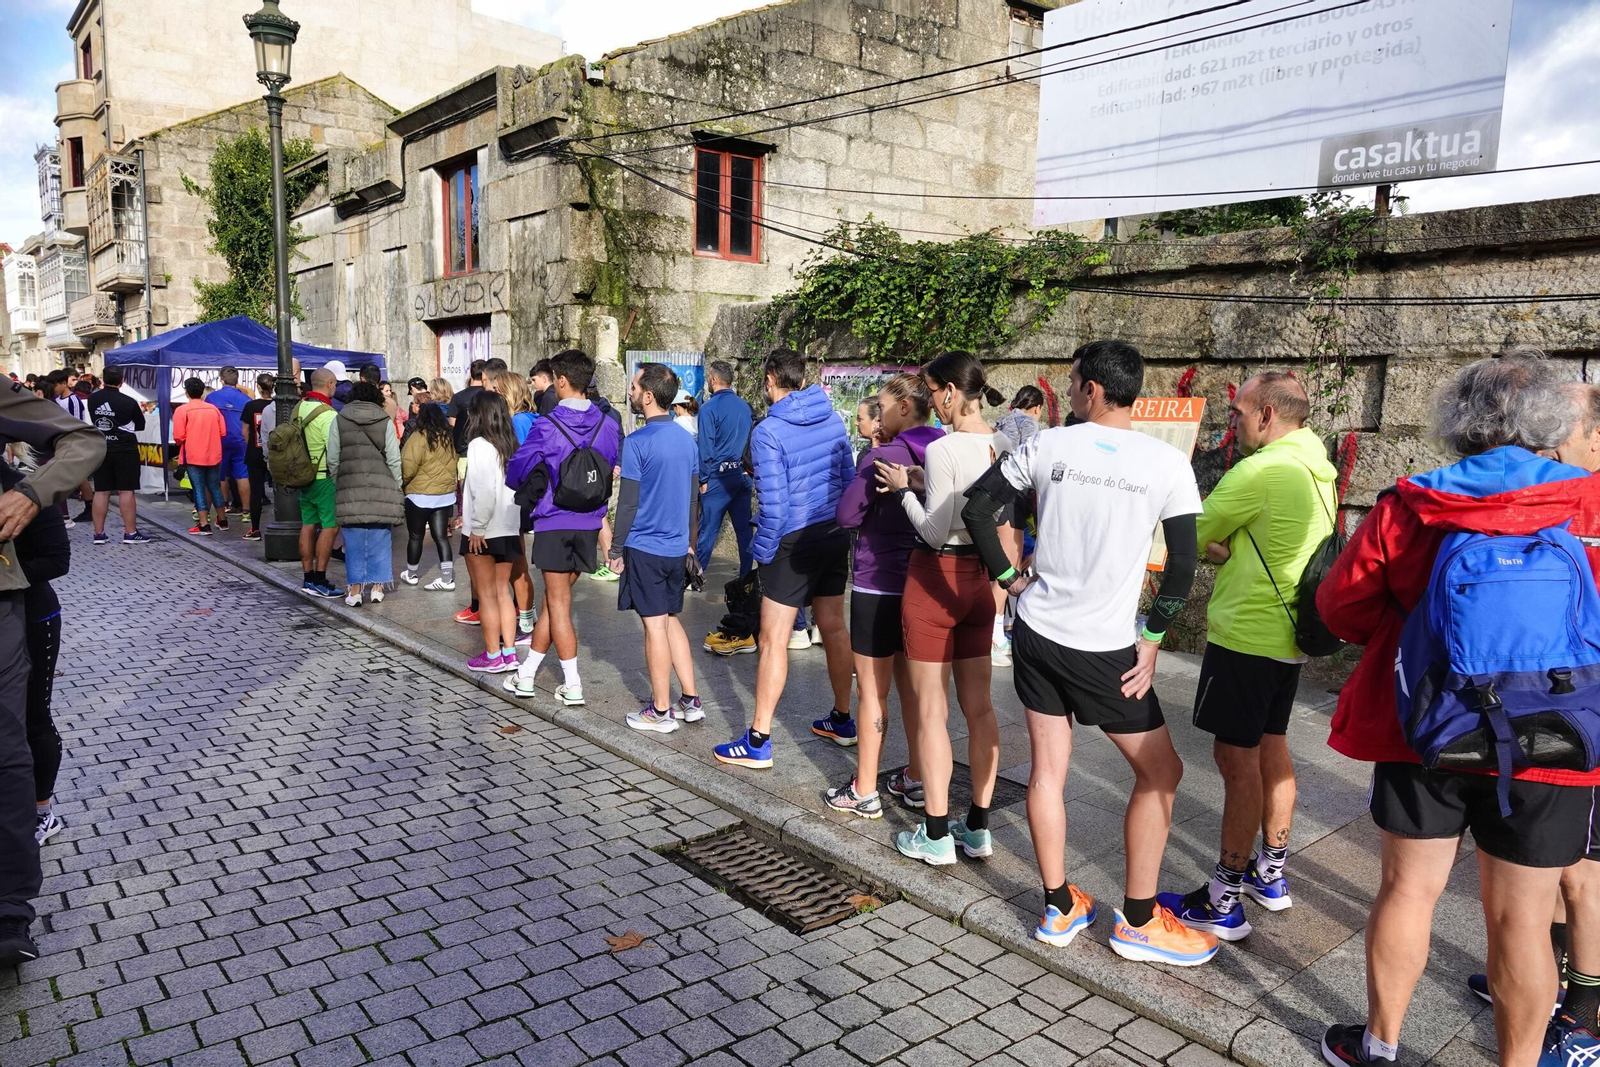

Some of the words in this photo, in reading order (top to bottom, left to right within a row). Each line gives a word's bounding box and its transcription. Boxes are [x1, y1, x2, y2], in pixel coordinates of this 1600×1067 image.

[1098, 64, 1196, 97] Edificabilidad:
[1200, 57, 1228, 75] 621
[1231, 48, 1264, 69] m2t
[1269, 31, 1343, 59] terciario
[1347, 30, 1357, 46] y
[1361, 17, 1414, 39] otros
[1164, 33, 1246, 60] TERCIARIO
[1090, 87, 1187, 118] Edificabilidad:
[1191, 80, 1219, 98] 967
[1222, 73, 1254, 92] m2t
[1259, 65, 1304, 86] (libre
[1308, 61, 1317, 77] y
[1321, 36, 1422, 75] protegida)
[1333, 130, 1481, 171] casaktua
[1332, 171, 1360, 183] donde
[1362, 168, 1381, 179] vive
[1383, 168, 1393, 177] tu
[1395, 165, 1416, 175] casa
[1418, 165, 1424, 175] y
[1426, 162, 1436, 171] tu
[1439, 157, 1480, 170] negocio
[94, 409, 116, 417] adidas
[1130, 400, 1194, 418] REIRA
[1067, 469, 1102, 486] Folgoso
[1104, 476, 1116, 488] do
[1118, 478, 1149, 495] Caurel
[1497, 557, 1523, 566] TENTH
[1119, 926, 1149, 943] HOKA
